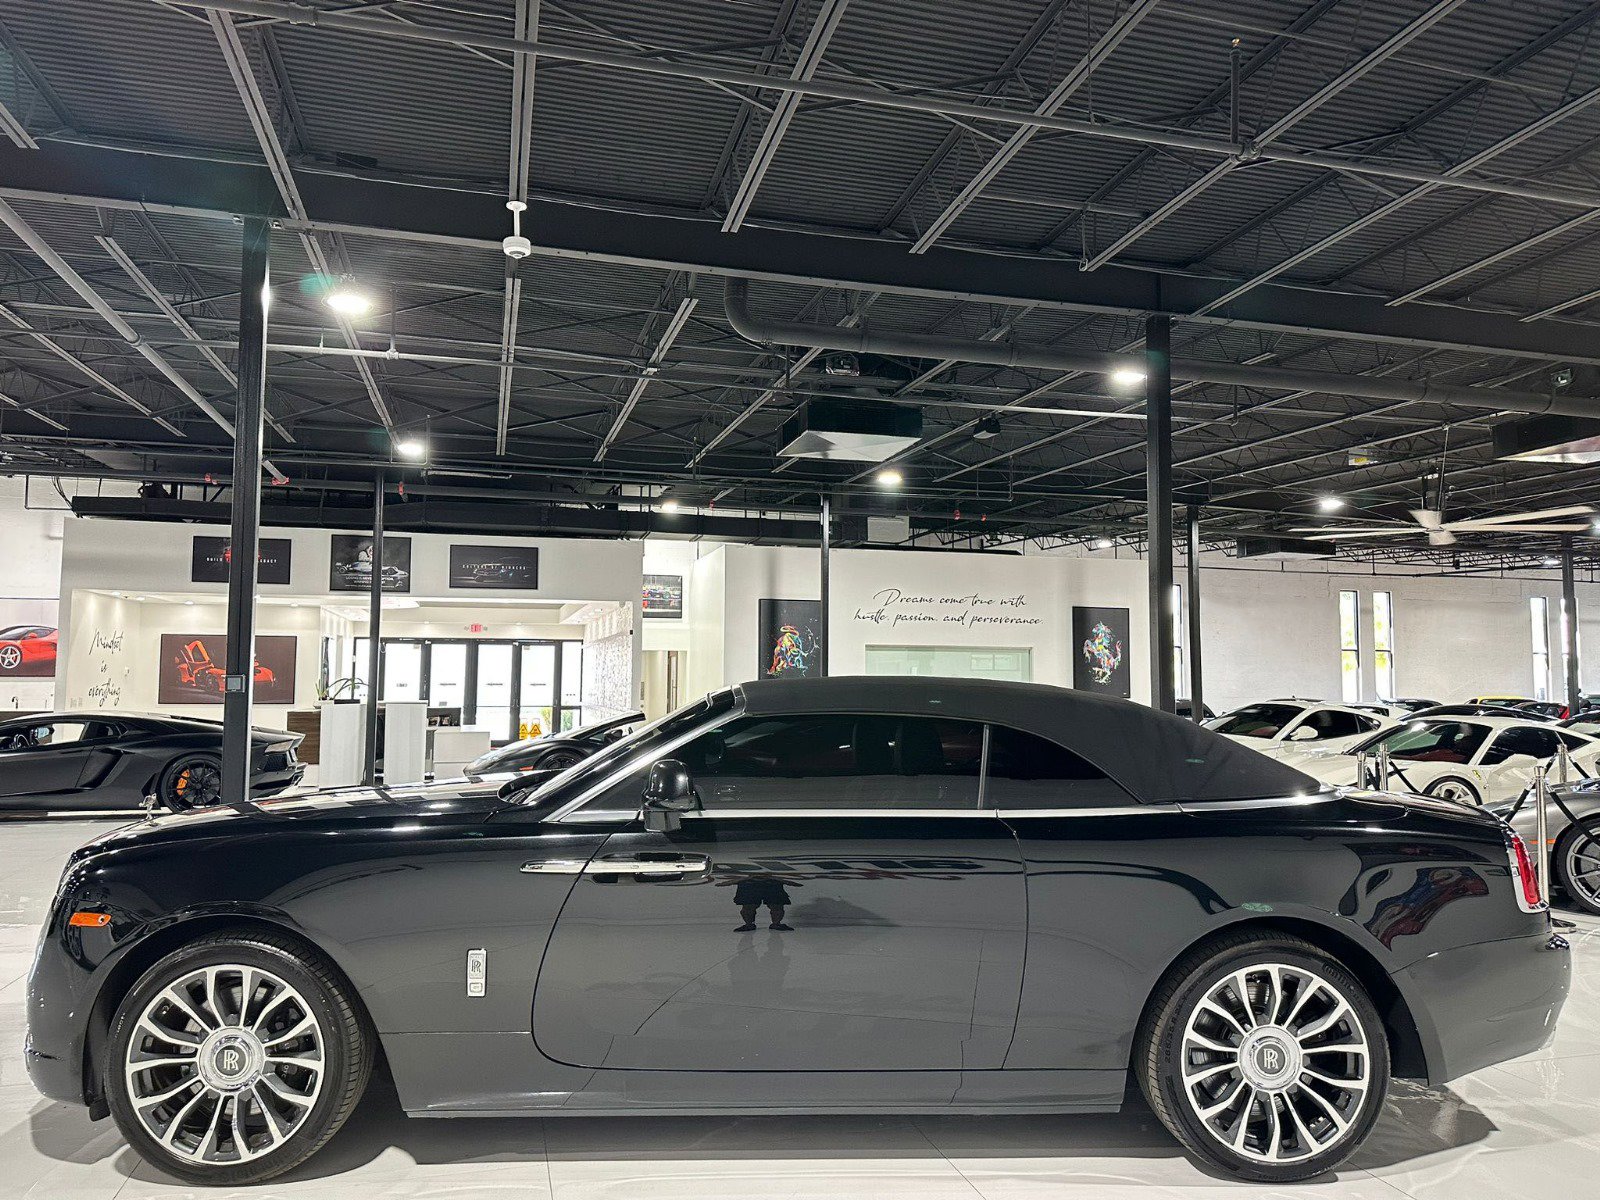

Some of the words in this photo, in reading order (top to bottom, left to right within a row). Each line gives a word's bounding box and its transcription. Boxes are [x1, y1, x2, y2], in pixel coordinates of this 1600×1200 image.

[872, 588, 935, 607] Dreams
[964, 593, 996, 607] true
[1000, 594, 1027, 608] with
[942, 610, 969, 626] and
[88, 627, 124, 655] Mindset
[101, 660, 107, 673] is
[88, 678, 121, 707] everything
